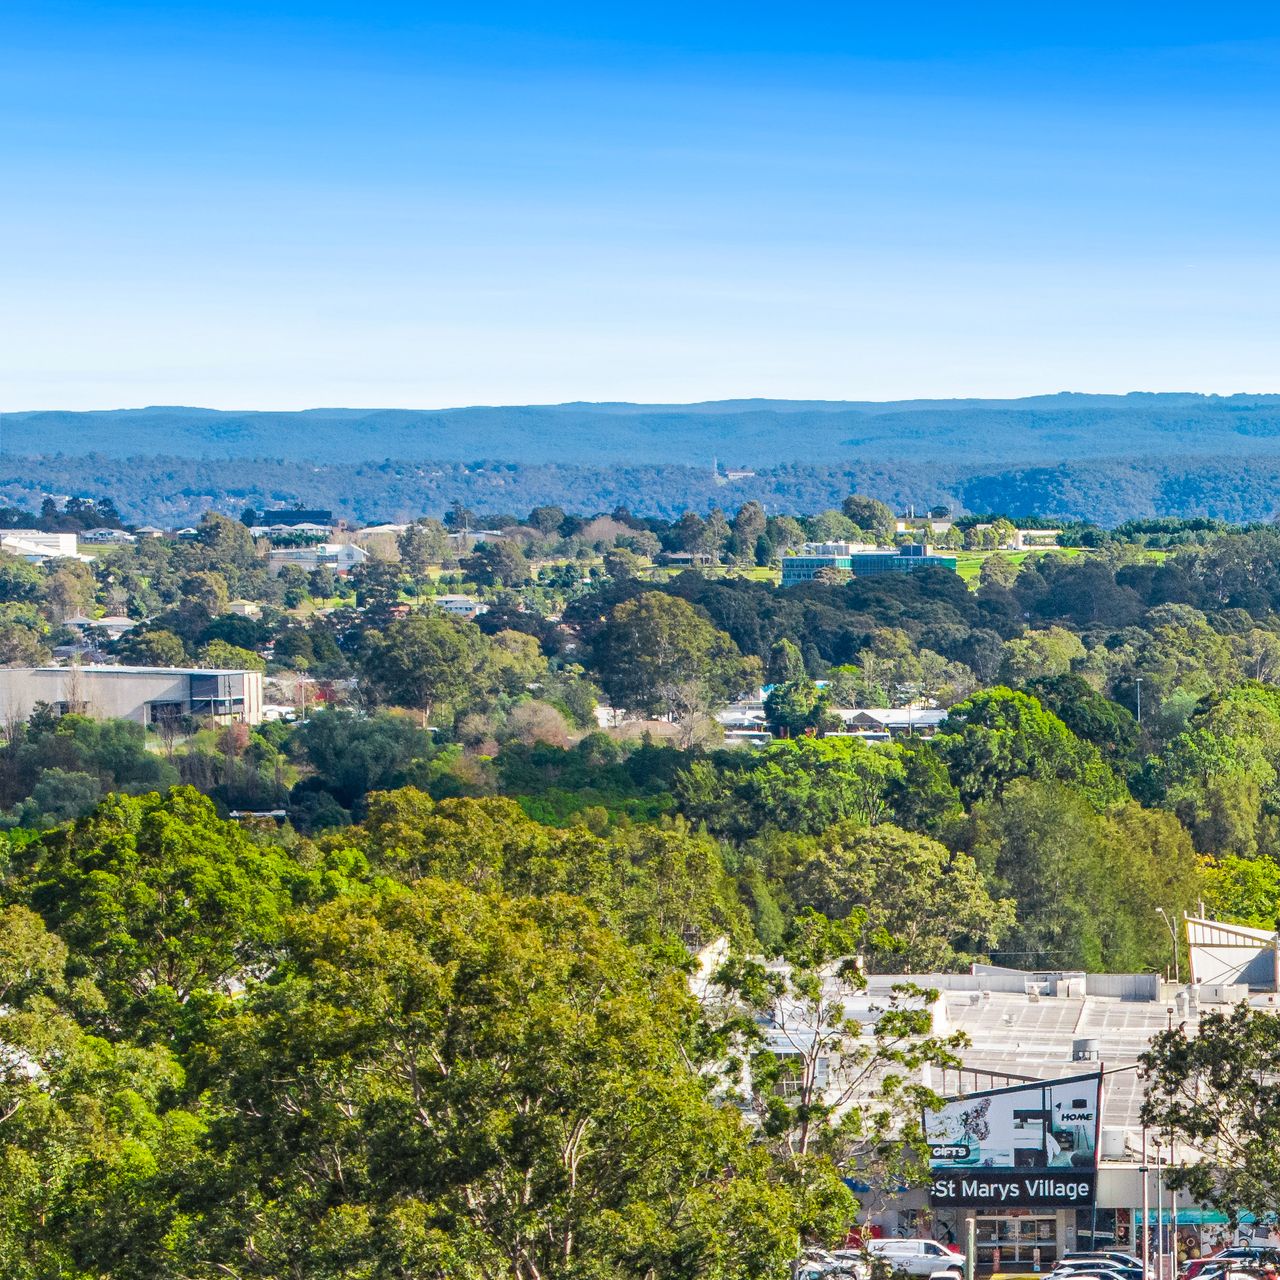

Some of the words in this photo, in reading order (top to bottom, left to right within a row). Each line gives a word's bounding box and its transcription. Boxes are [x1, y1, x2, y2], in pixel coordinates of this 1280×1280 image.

[1061, 1113, 1093, 1122] HOME
[933, 1146, 967, 1157] GIFTS
[935, 1179, 956, 1197] St
[962, 1180, 1020, 1200] Marys
[1025, 1179, 1090, 1200] Village
